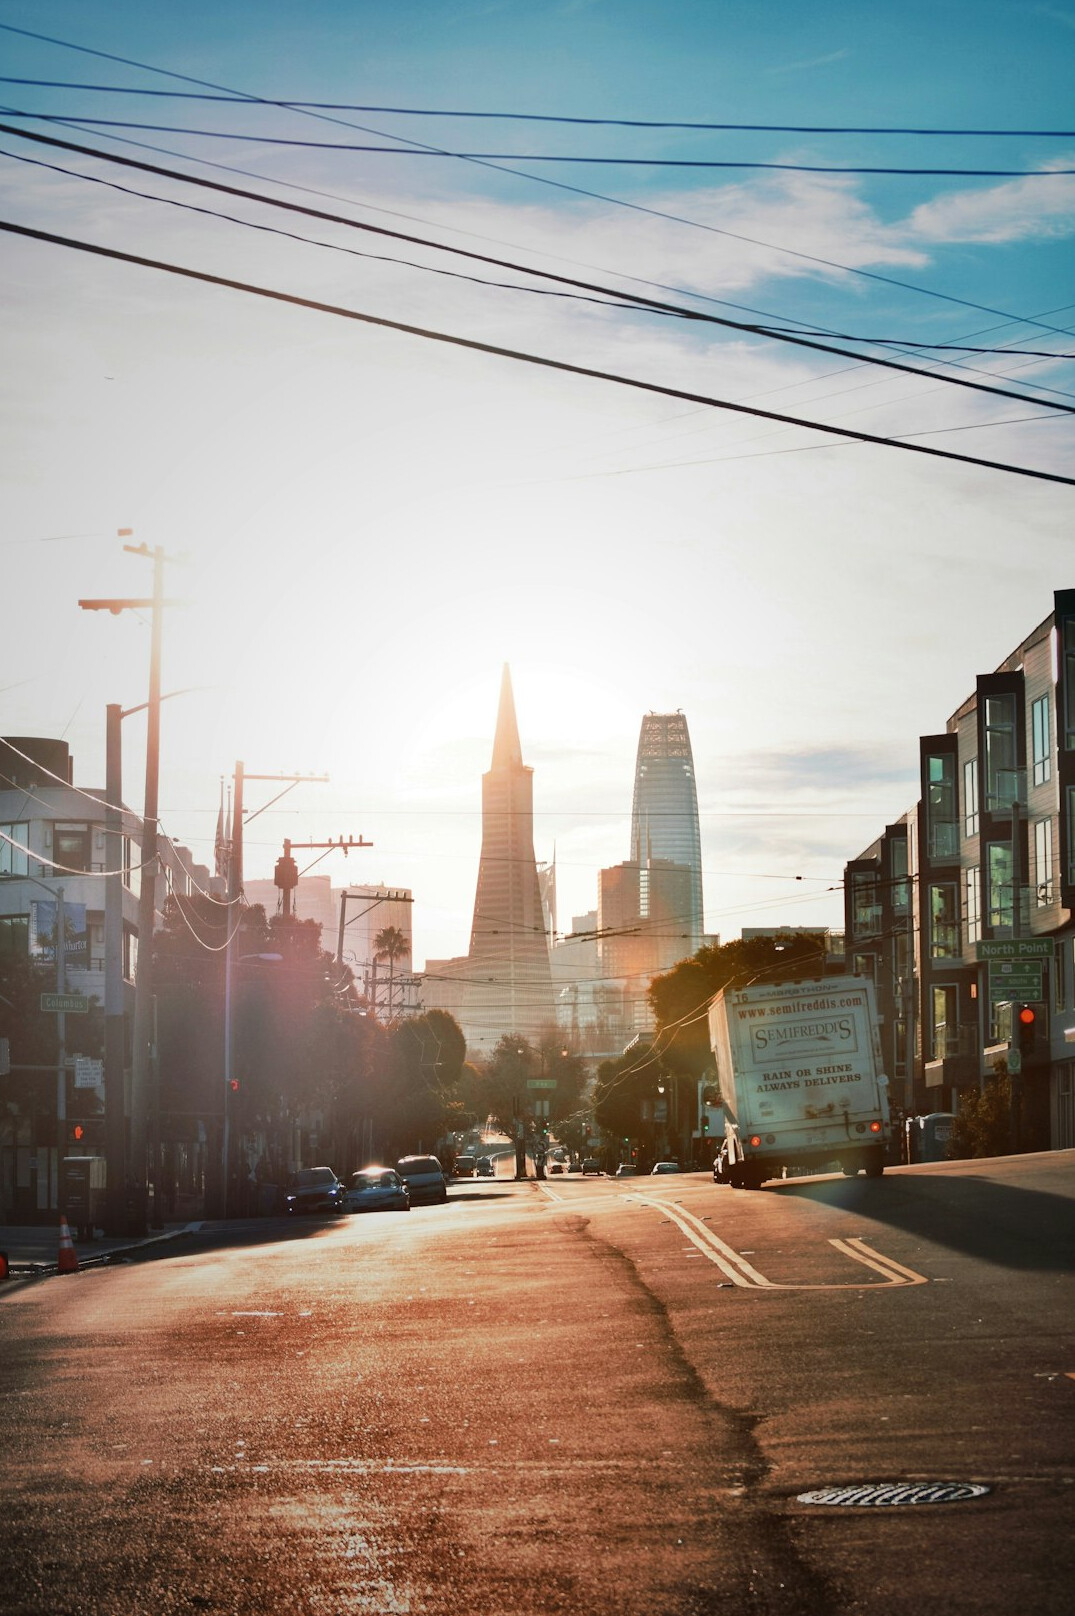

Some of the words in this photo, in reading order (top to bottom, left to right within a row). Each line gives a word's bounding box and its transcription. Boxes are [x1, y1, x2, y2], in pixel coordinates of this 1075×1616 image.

[981, 944, 1014, 956] North
[1018, 942, 1049, 954] Point
[46, 997, 84, 1008] Columbus
[735, 992, 749, 1005] 16
[738, 997, 862, 1020] www.semifreddis.com
[762, 1070, 792, 1082] RAIN
[796, 1068, 812, 1078] OR
[816, 1063, 853, 1075] SHINE
[756, 1080, 800, 1093] ALWAYS
[805, 1073, 862, 1088] DELIVERS
